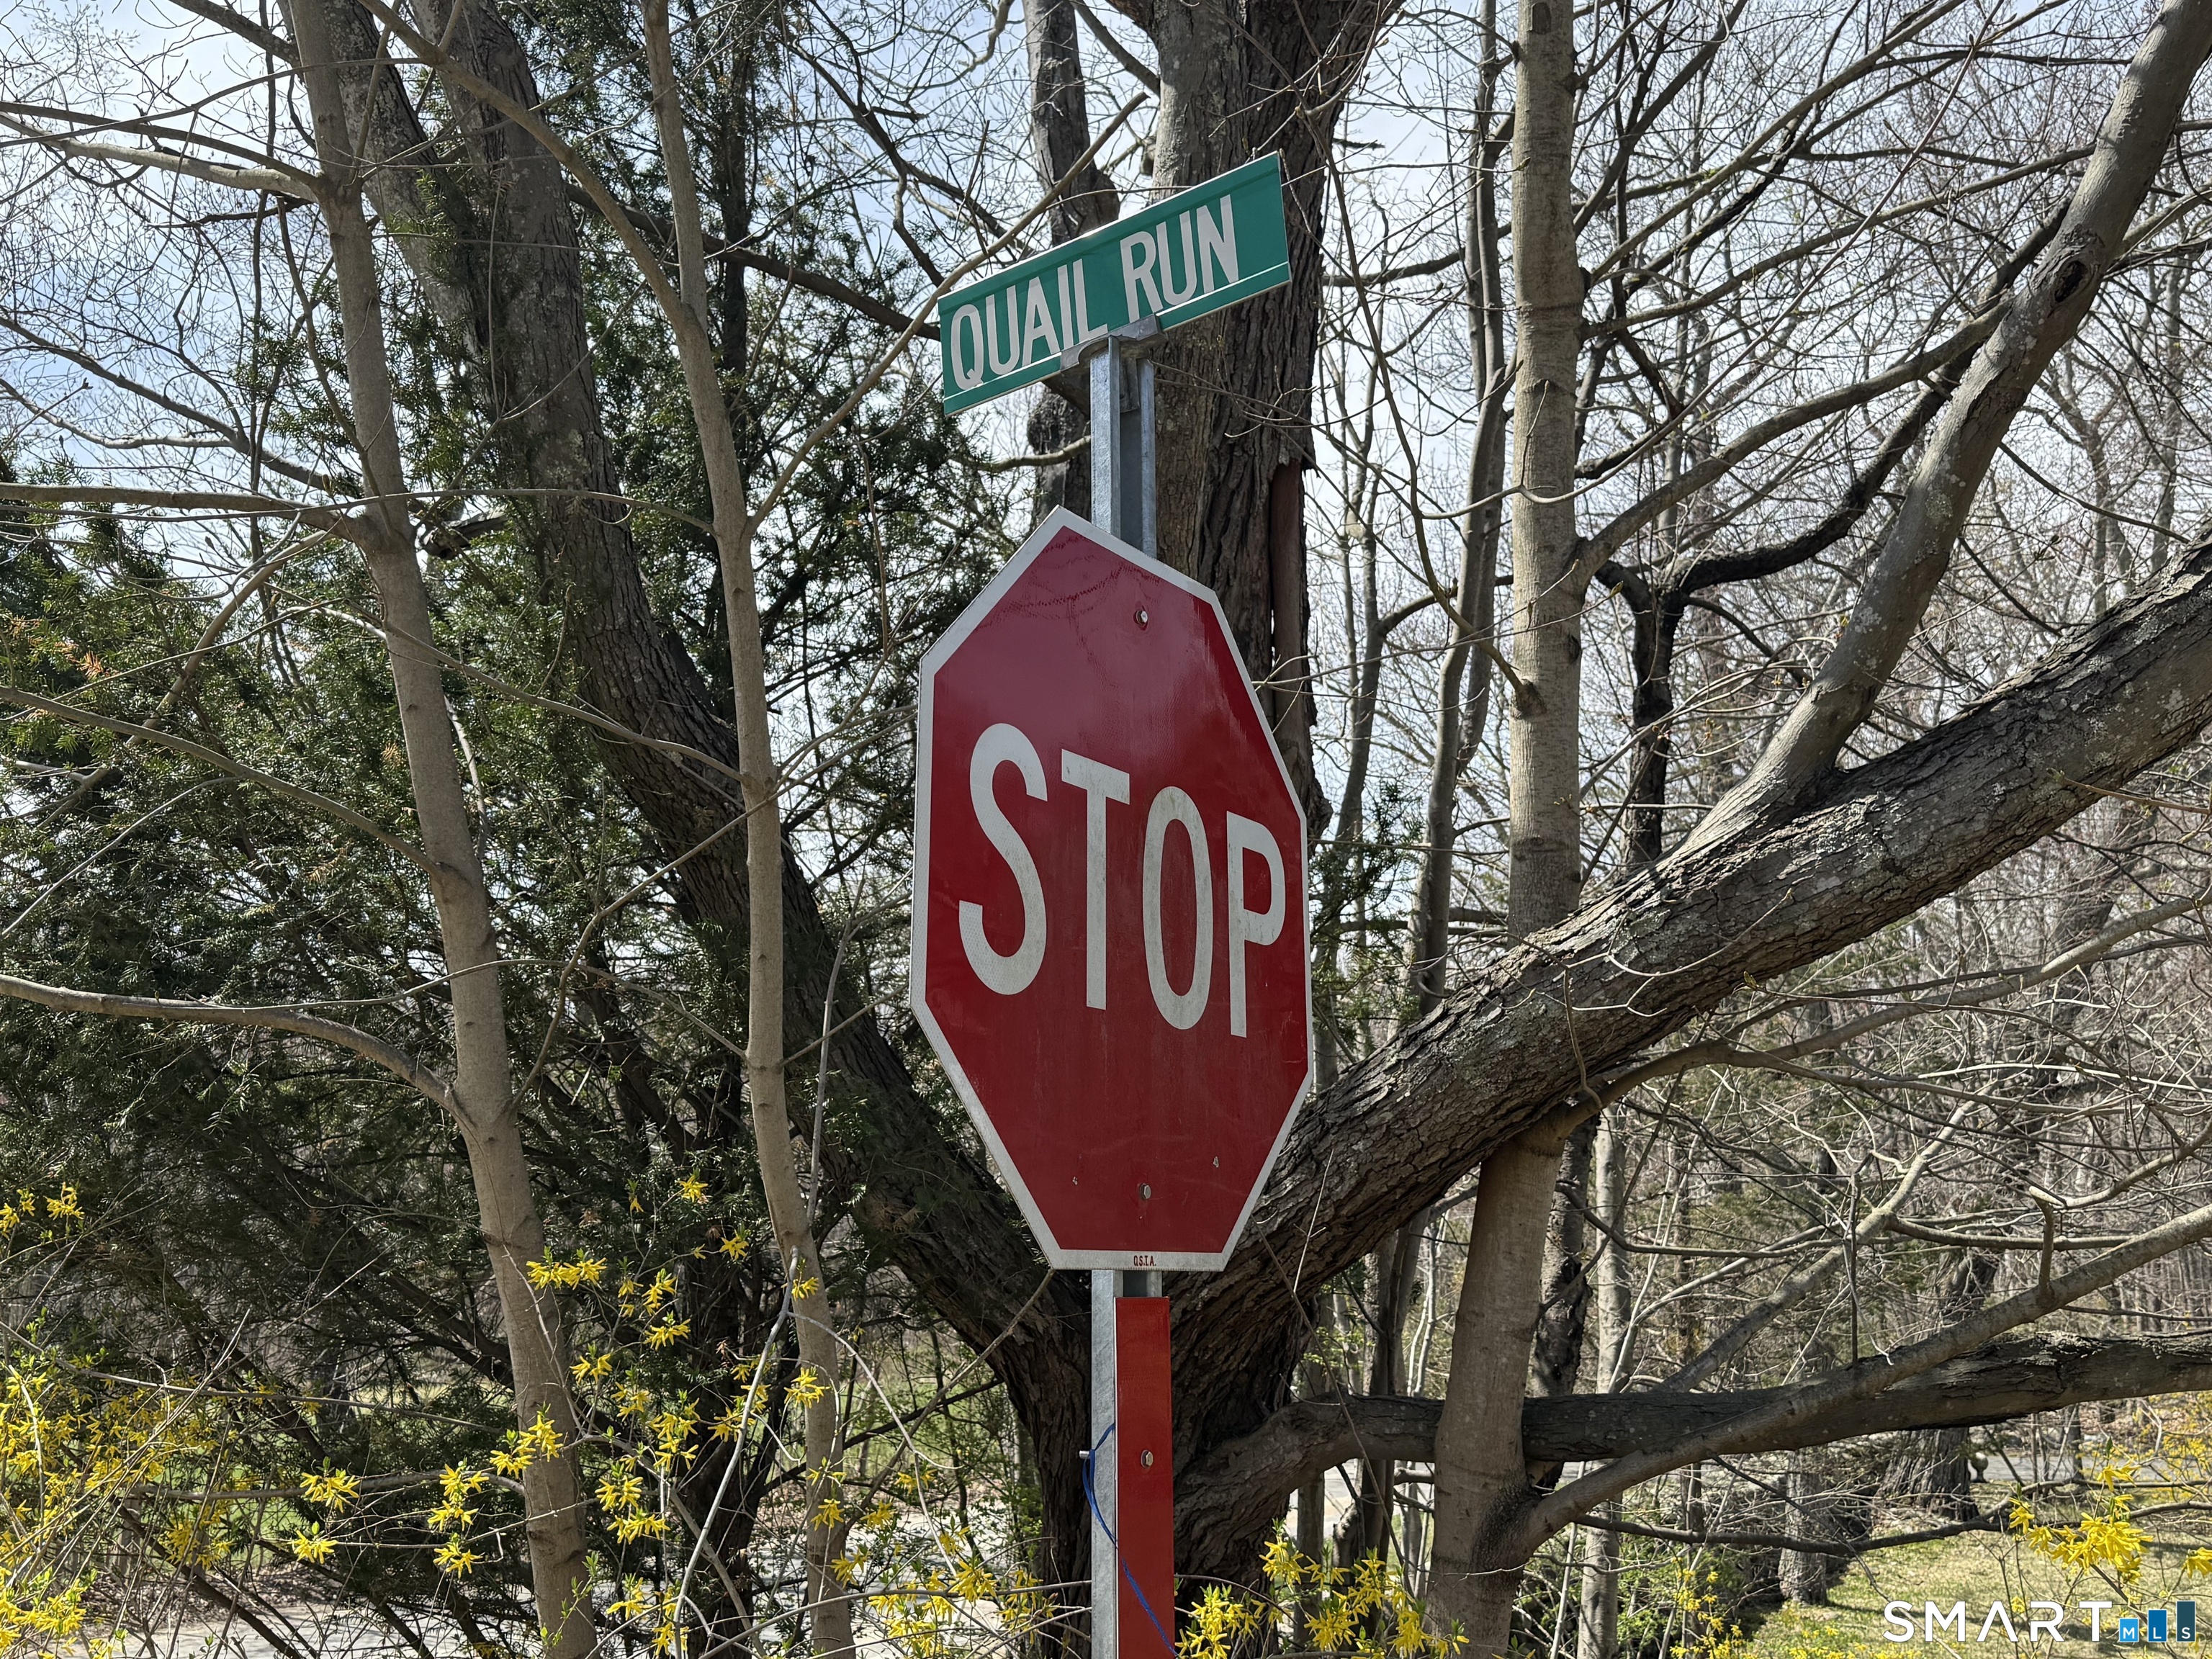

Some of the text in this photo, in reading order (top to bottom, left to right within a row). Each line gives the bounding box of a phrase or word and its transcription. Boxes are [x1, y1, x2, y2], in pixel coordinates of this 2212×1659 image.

[950, 194, 1239, 390] QUAIL RUN
[959, 723, 1286, 1038] STOP
